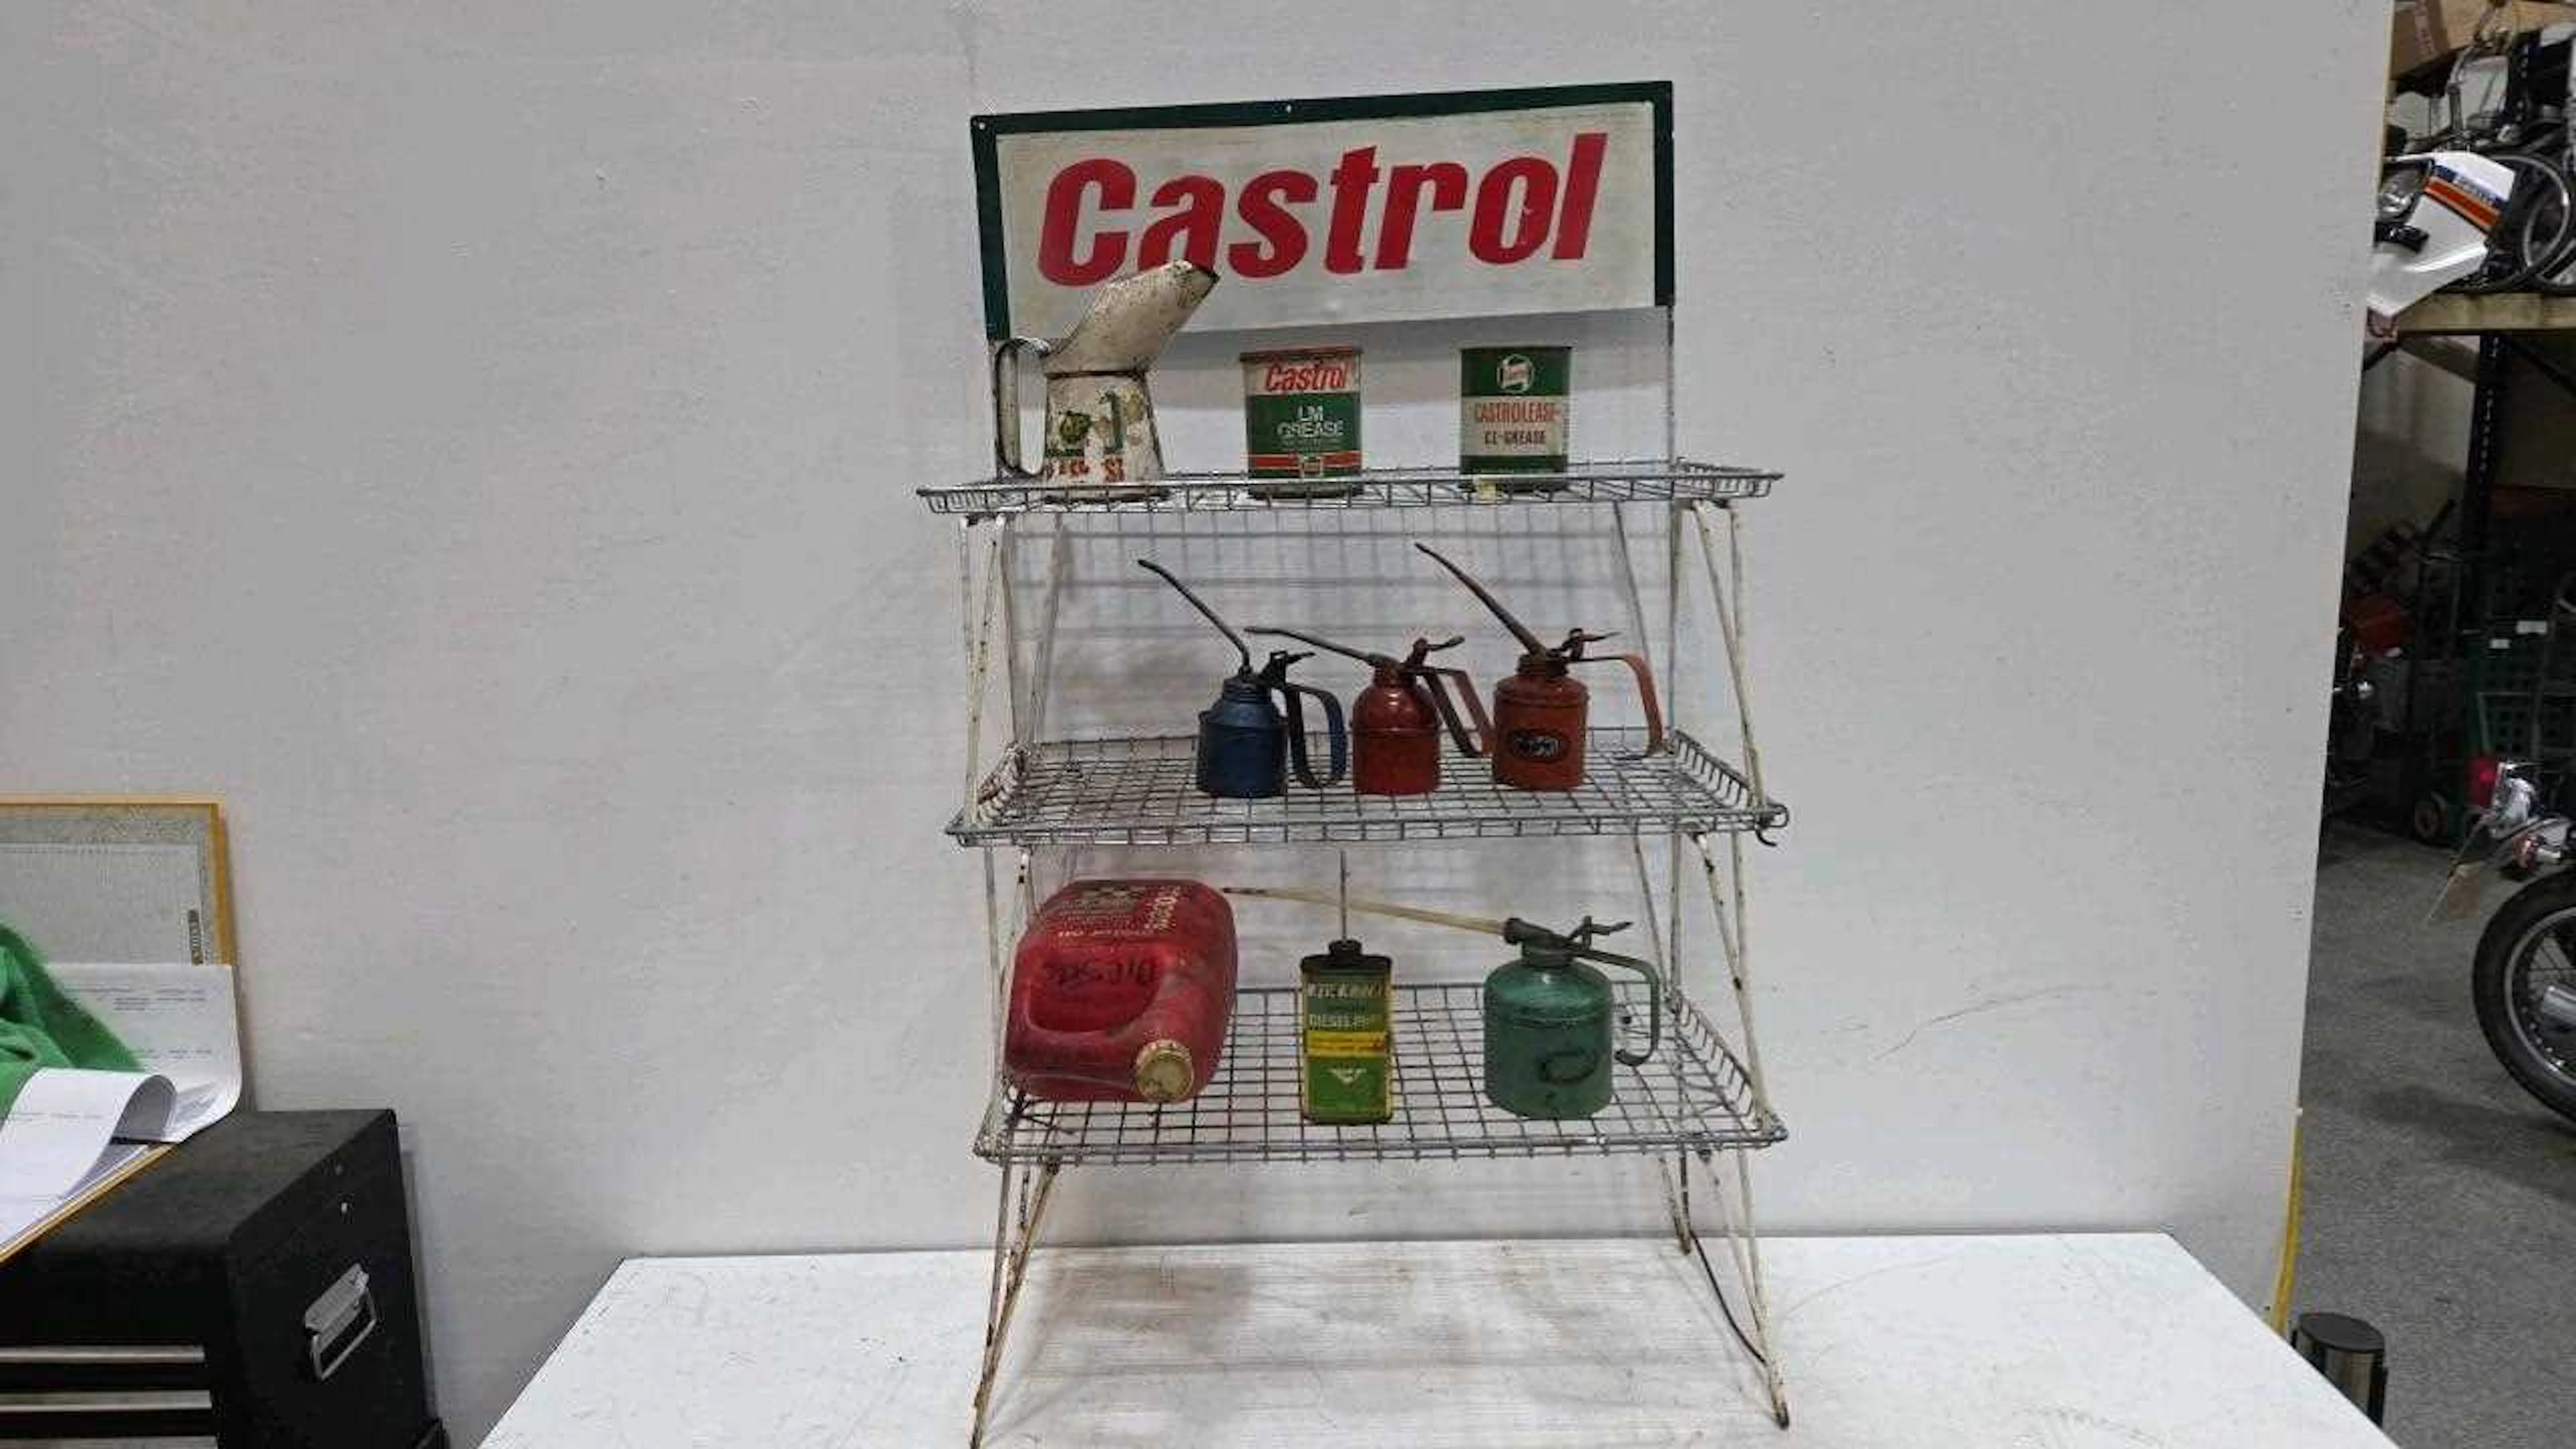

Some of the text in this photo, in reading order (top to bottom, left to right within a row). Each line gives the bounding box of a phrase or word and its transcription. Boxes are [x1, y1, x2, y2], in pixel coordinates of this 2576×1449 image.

[1038, 133, 1608, 287] Castrol
[1265, 362, 1353, 391] Castrol
[1276, 419, 1344, 437] GREASE
